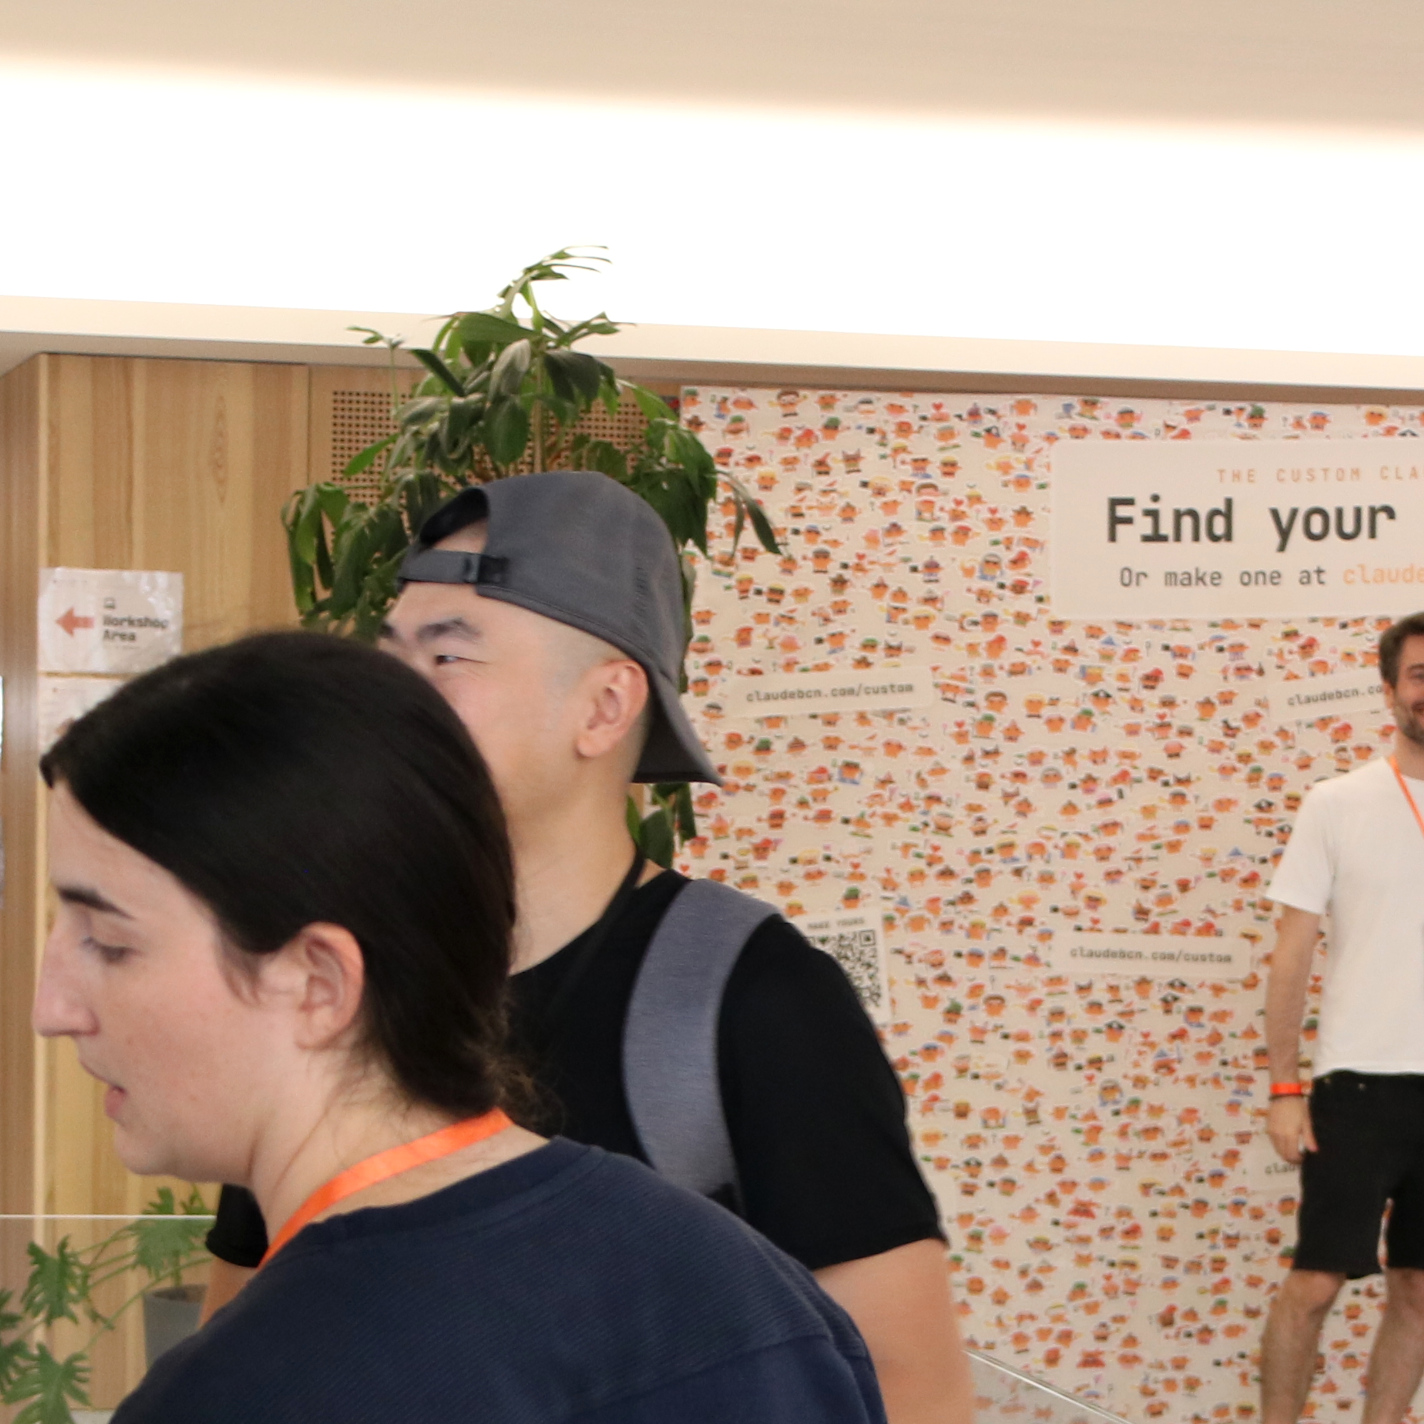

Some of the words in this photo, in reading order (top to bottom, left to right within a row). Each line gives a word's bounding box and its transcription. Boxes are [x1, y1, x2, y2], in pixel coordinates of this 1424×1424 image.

[1217, 468, 1256, 484] THE
[1276, 467, 1361, 483] CUSTOM
[1107, 493, 1233, 543] Find
[1268, 504, 1396, 553] your
[1120, 567, 1149, 587] Or
[1164, 567, 1223, 587] make
[1239, 571, 1282, 587] one
[1298, 566, 1326, 585] at
[746, 683, 914, 702] claudebcn.com/custom
[1287, 684, 1384, 706] claudebcn.co
